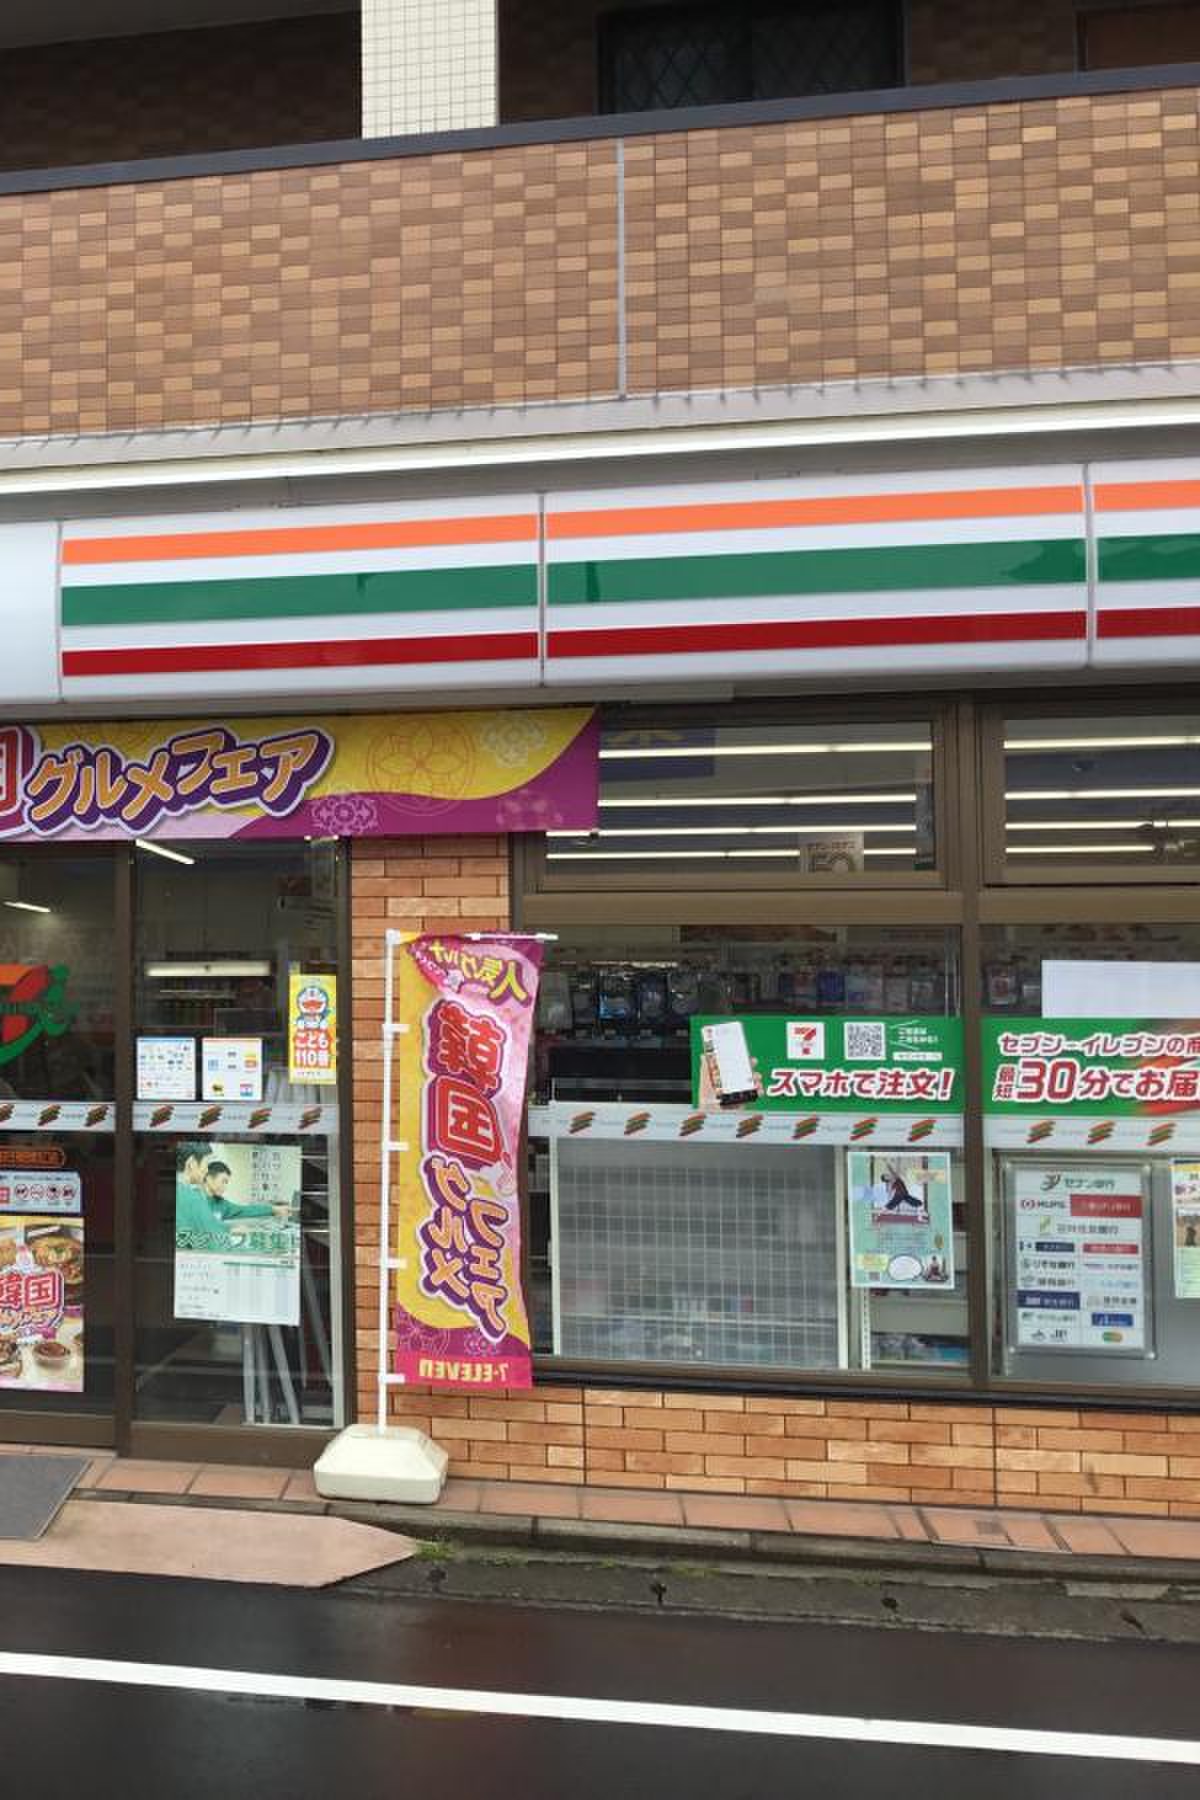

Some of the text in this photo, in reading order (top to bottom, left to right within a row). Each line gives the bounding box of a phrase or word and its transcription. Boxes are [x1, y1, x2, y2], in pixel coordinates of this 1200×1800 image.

[770, 1070, 954, 1098] スマホで注文!
